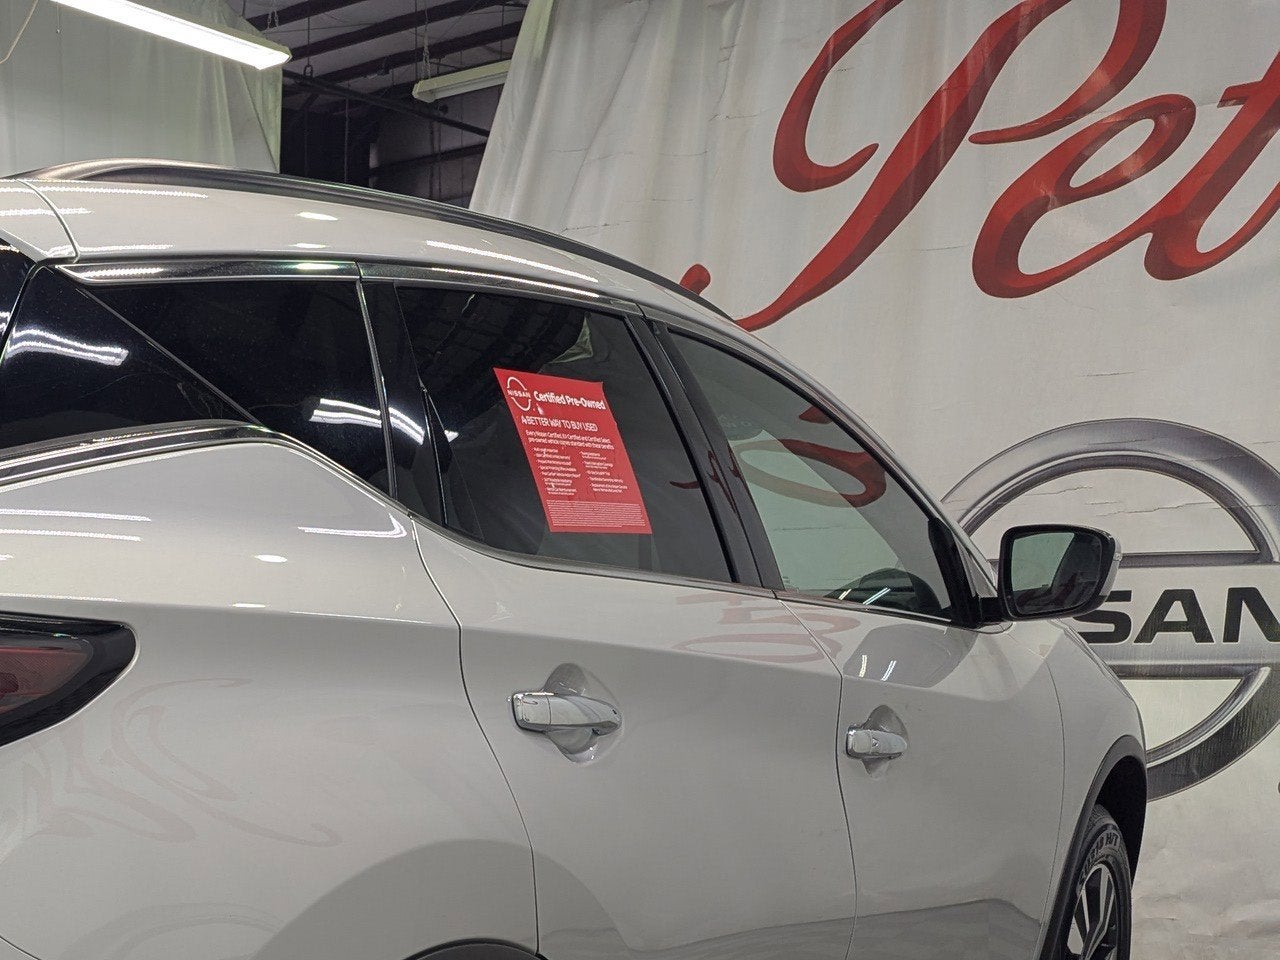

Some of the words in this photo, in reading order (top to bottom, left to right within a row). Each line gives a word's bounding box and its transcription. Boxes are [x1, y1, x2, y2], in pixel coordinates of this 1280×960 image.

[533, 390, 566, 405] Certified
[565, 395, 606, 410] Pre-Owned
[526, 415, 550, 427] BETTER
[562, 419, 571, 429] TO
[583, 422, 598, 432] USED
